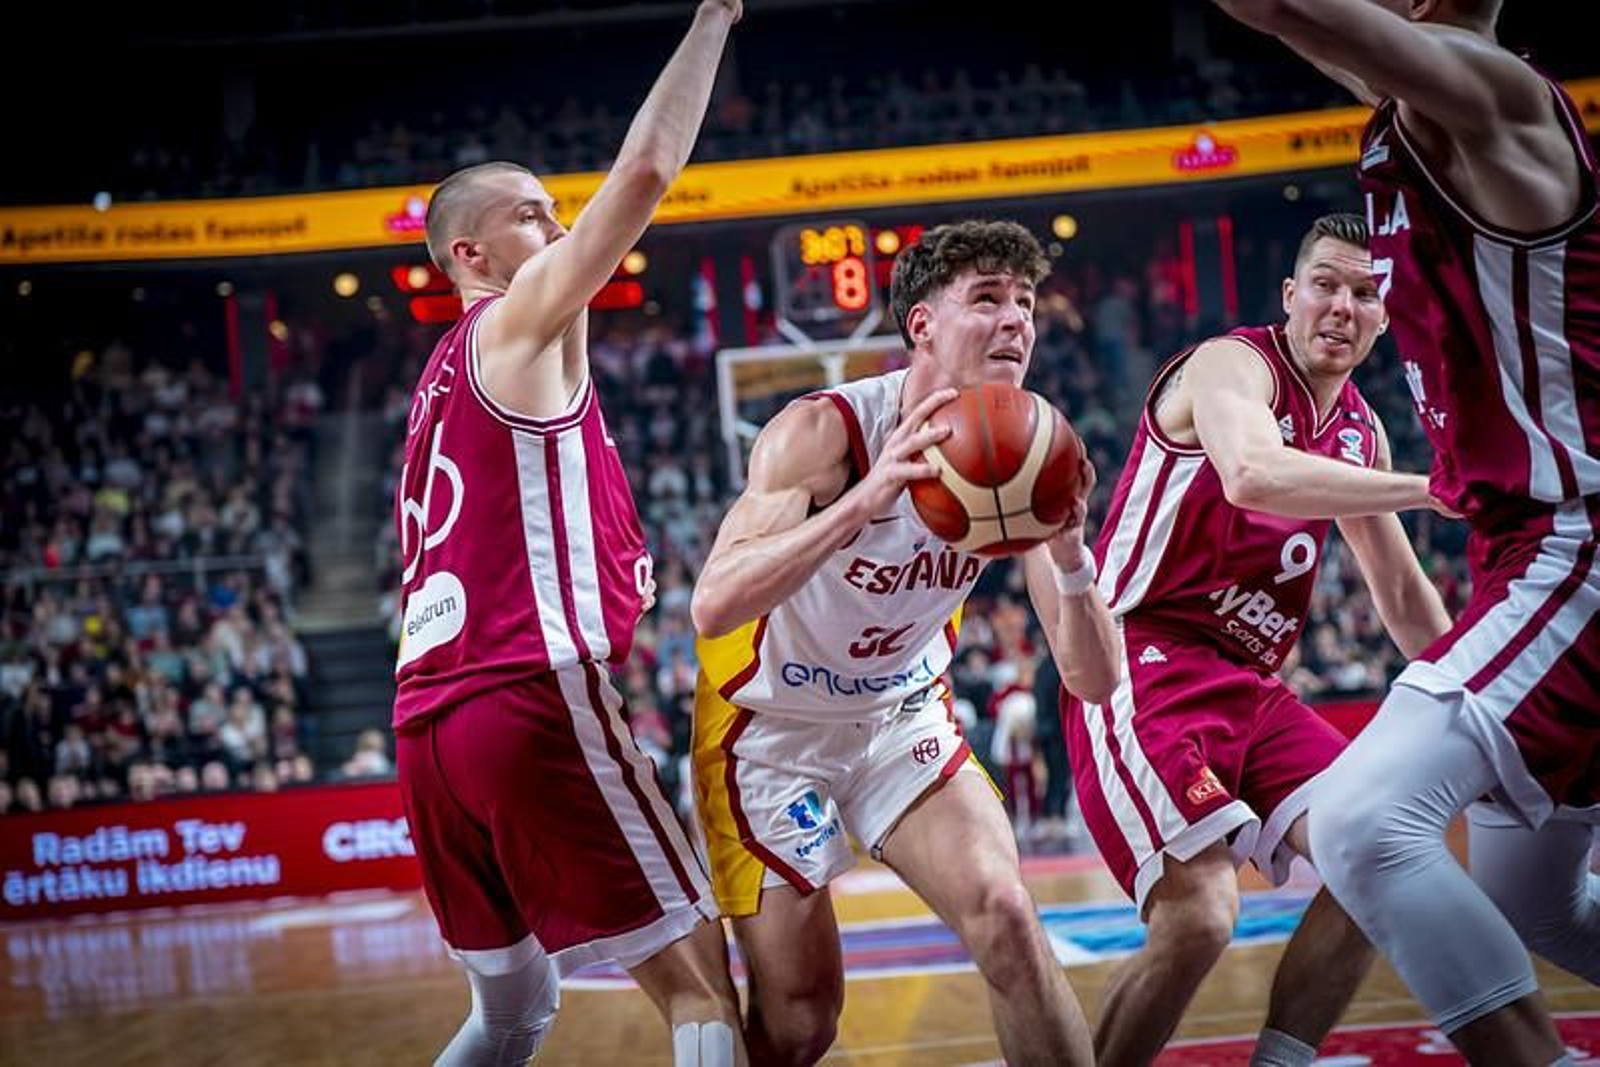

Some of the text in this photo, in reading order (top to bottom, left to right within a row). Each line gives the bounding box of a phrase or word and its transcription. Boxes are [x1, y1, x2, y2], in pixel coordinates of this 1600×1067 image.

[832, 256, 870, 311] 8
[1274, 531, 1317, 585] 9
[32, 818, 246, 866] Radām Tev
[3, 854, 281, 905] ērtāku ikdienu
